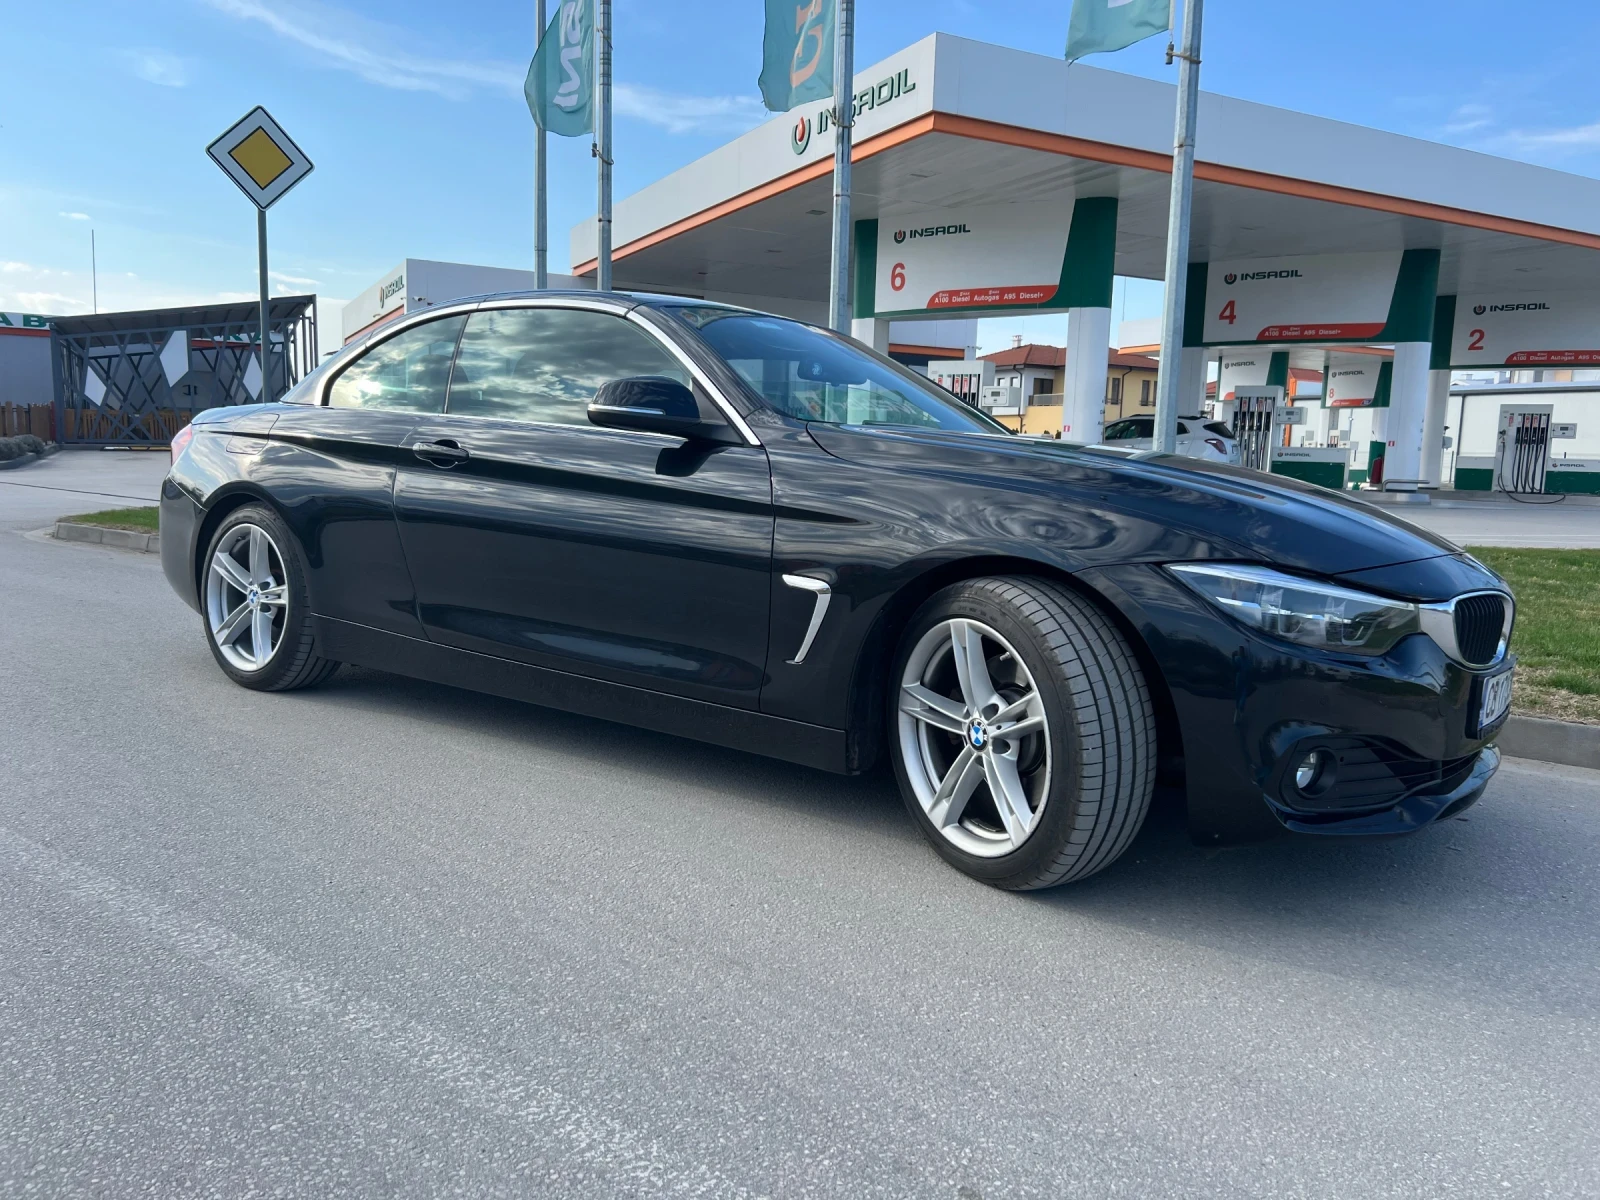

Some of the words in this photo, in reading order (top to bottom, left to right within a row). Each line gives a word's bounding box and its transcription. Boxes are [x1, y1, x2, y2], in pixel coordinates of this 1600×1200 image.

[816, 68, 916, 135] INAOIL
[909, 224, 971, 239] INSAOIL
[890, 262, 906, 292] 6
[1240, 269, 1303, 281] INSAOIL
[973, 294, 1000, 302] Autogas
[1003, 292, 1016, 300] A95
[1019, 291, 1044, 299] Diesel+
[1218, 300, 1237, 325] 4
[1489, 302, 1550, 312] INSAOIL
[1467, 328, 1486, 351] 2
[1329, 388, 1335, 398] 8
